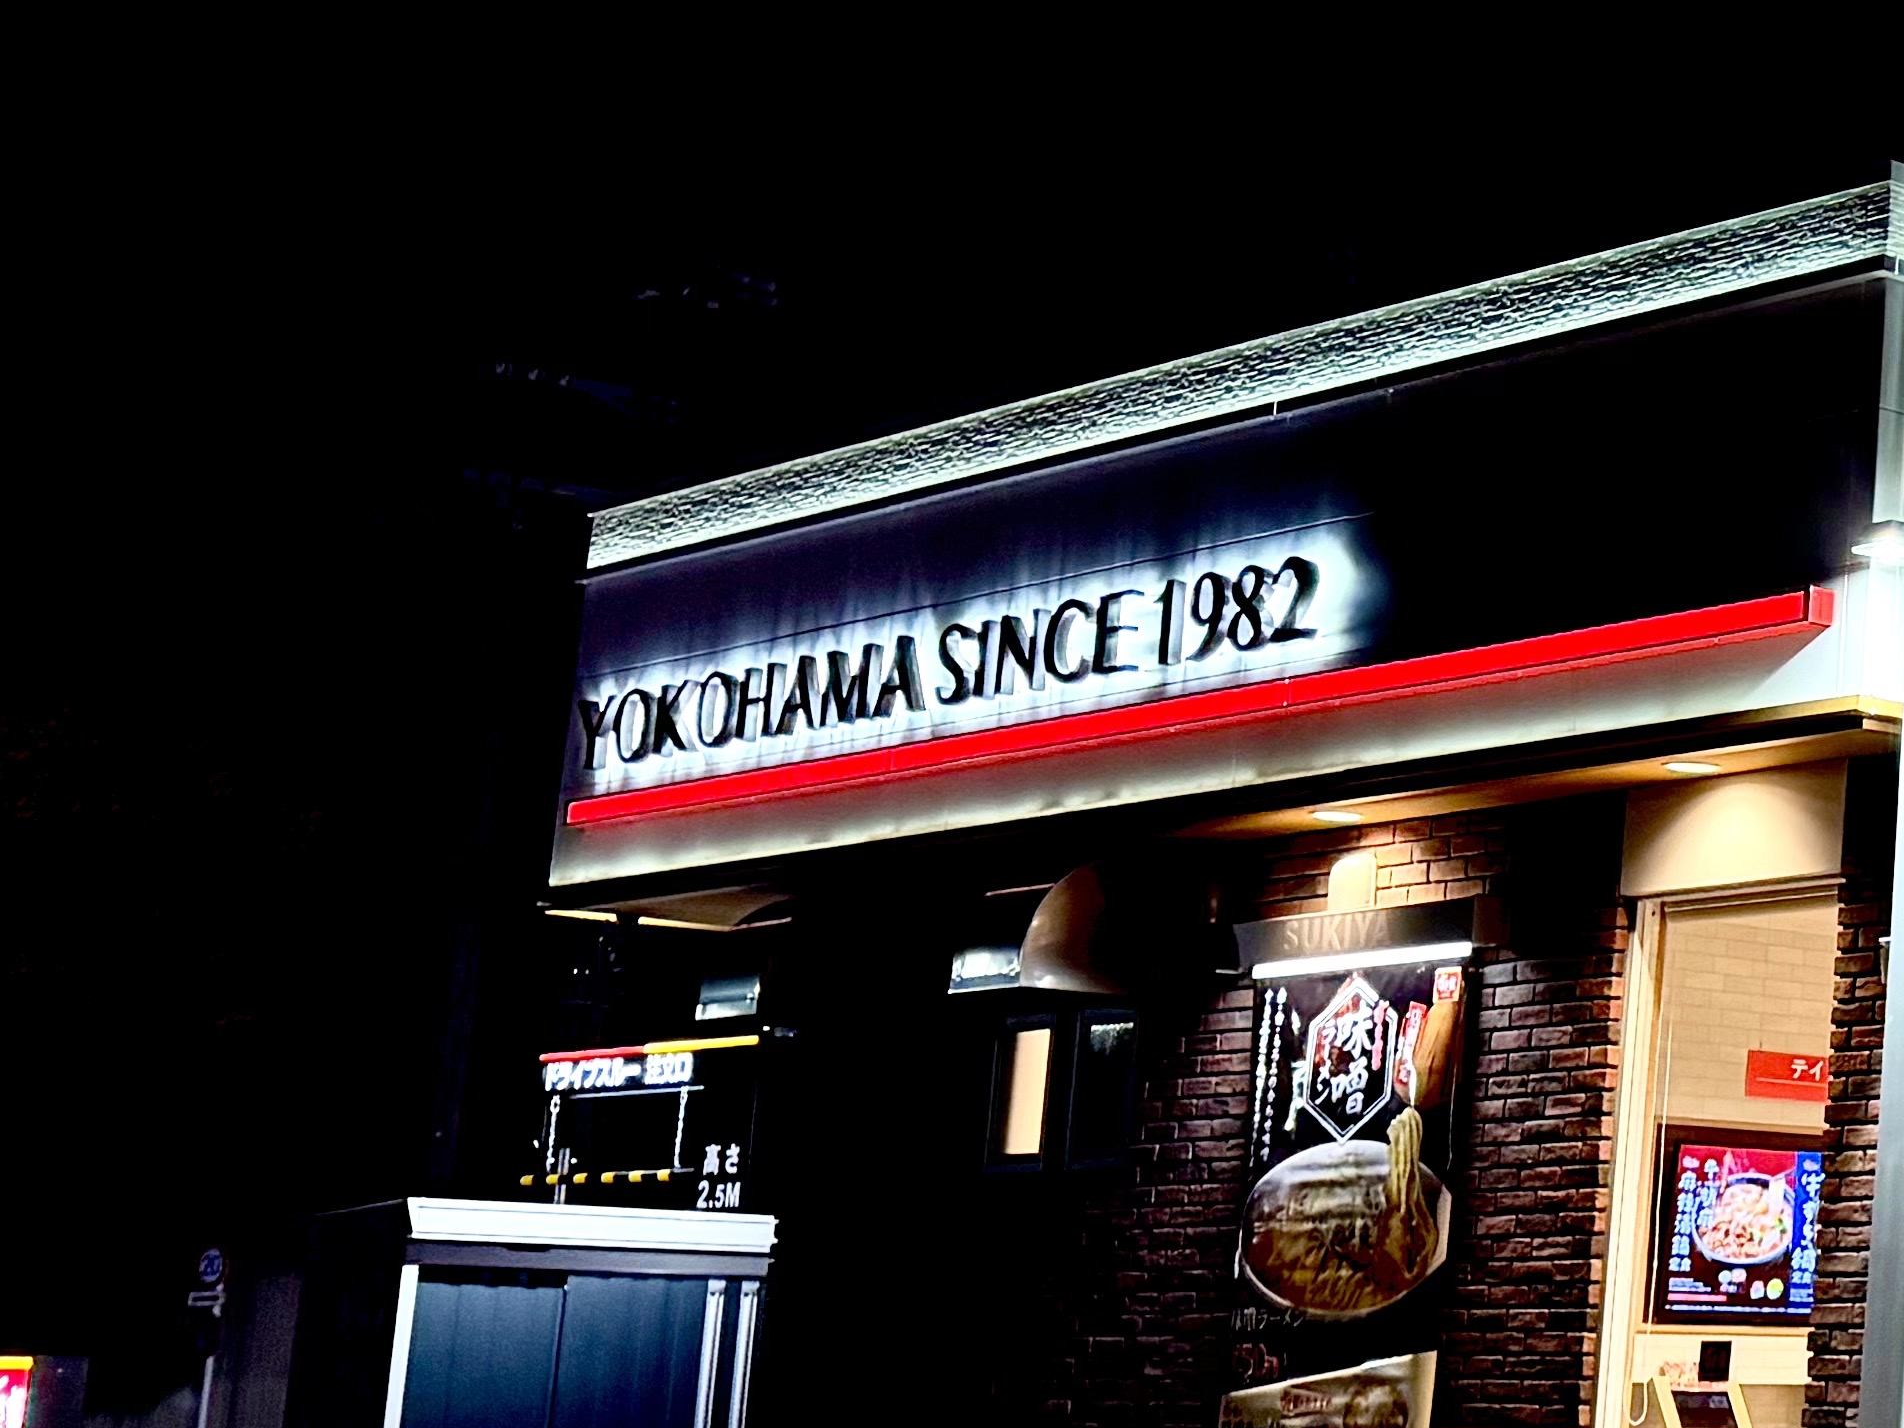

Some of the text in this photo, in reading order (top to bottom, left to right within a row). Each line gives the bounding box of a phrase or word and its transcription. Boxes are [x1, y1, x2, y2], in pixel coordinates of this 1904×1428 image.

[576, 555, 1322, 772] YOKOHAMA SINCE 1982
[1283, 910, 1391, 951] SUKIYA
[1332, 999, 1375, 1115] 味噌
[702, 1142, 741, 1176] 高さ
[696, 1180, 741, 1209] 2.5M
